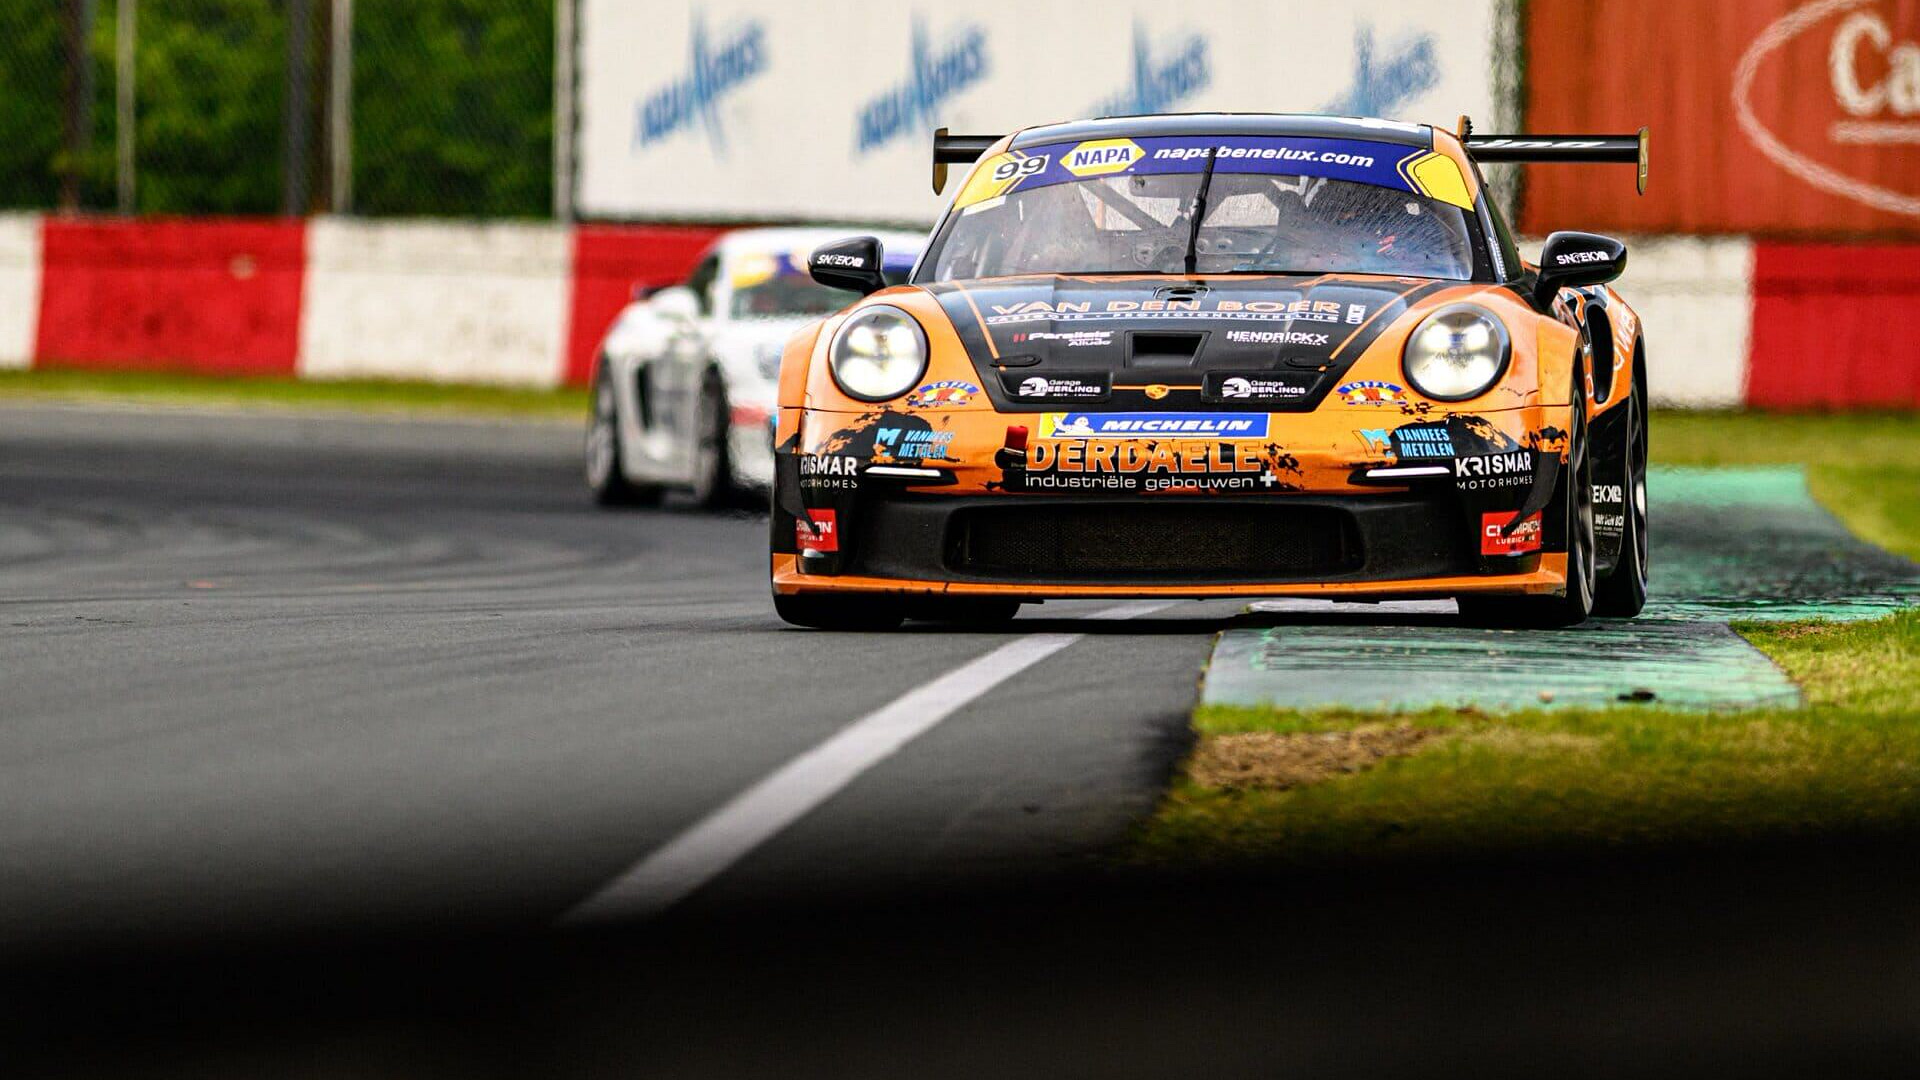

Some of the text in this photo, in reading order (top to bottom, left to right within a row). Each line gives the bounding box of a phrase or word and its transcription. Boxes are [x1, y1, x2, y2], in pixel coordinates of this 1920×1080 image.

[1073, 146, 1131, 166] NAPA
[1154, 146, 1374, 167] napabenelux.com
[996, 155, 1046, 180] 99
[991, 300, 1341, 315] VAN DEN BOER
[1226, 331, 1329, 344] HENDRICKX
[1049, 379, 1081, 387] Garage
[1101, 419, 1252, 431] MICHELIN
[1395, 428, 1450, 442] VANHEES
[898, 443, 948, 458] METALEN
[1026, 441, 1262, 473] DERDAELE
[1401, 443, 1455, 458] METALEN
[1455, 451, 1532, 477] KRISMAR
[1026, 473, 1136, 488] industriële
[1145, 474, 1253, 491] gebouwen
[1456, 475, 1533, 490] MOTORHOMES
